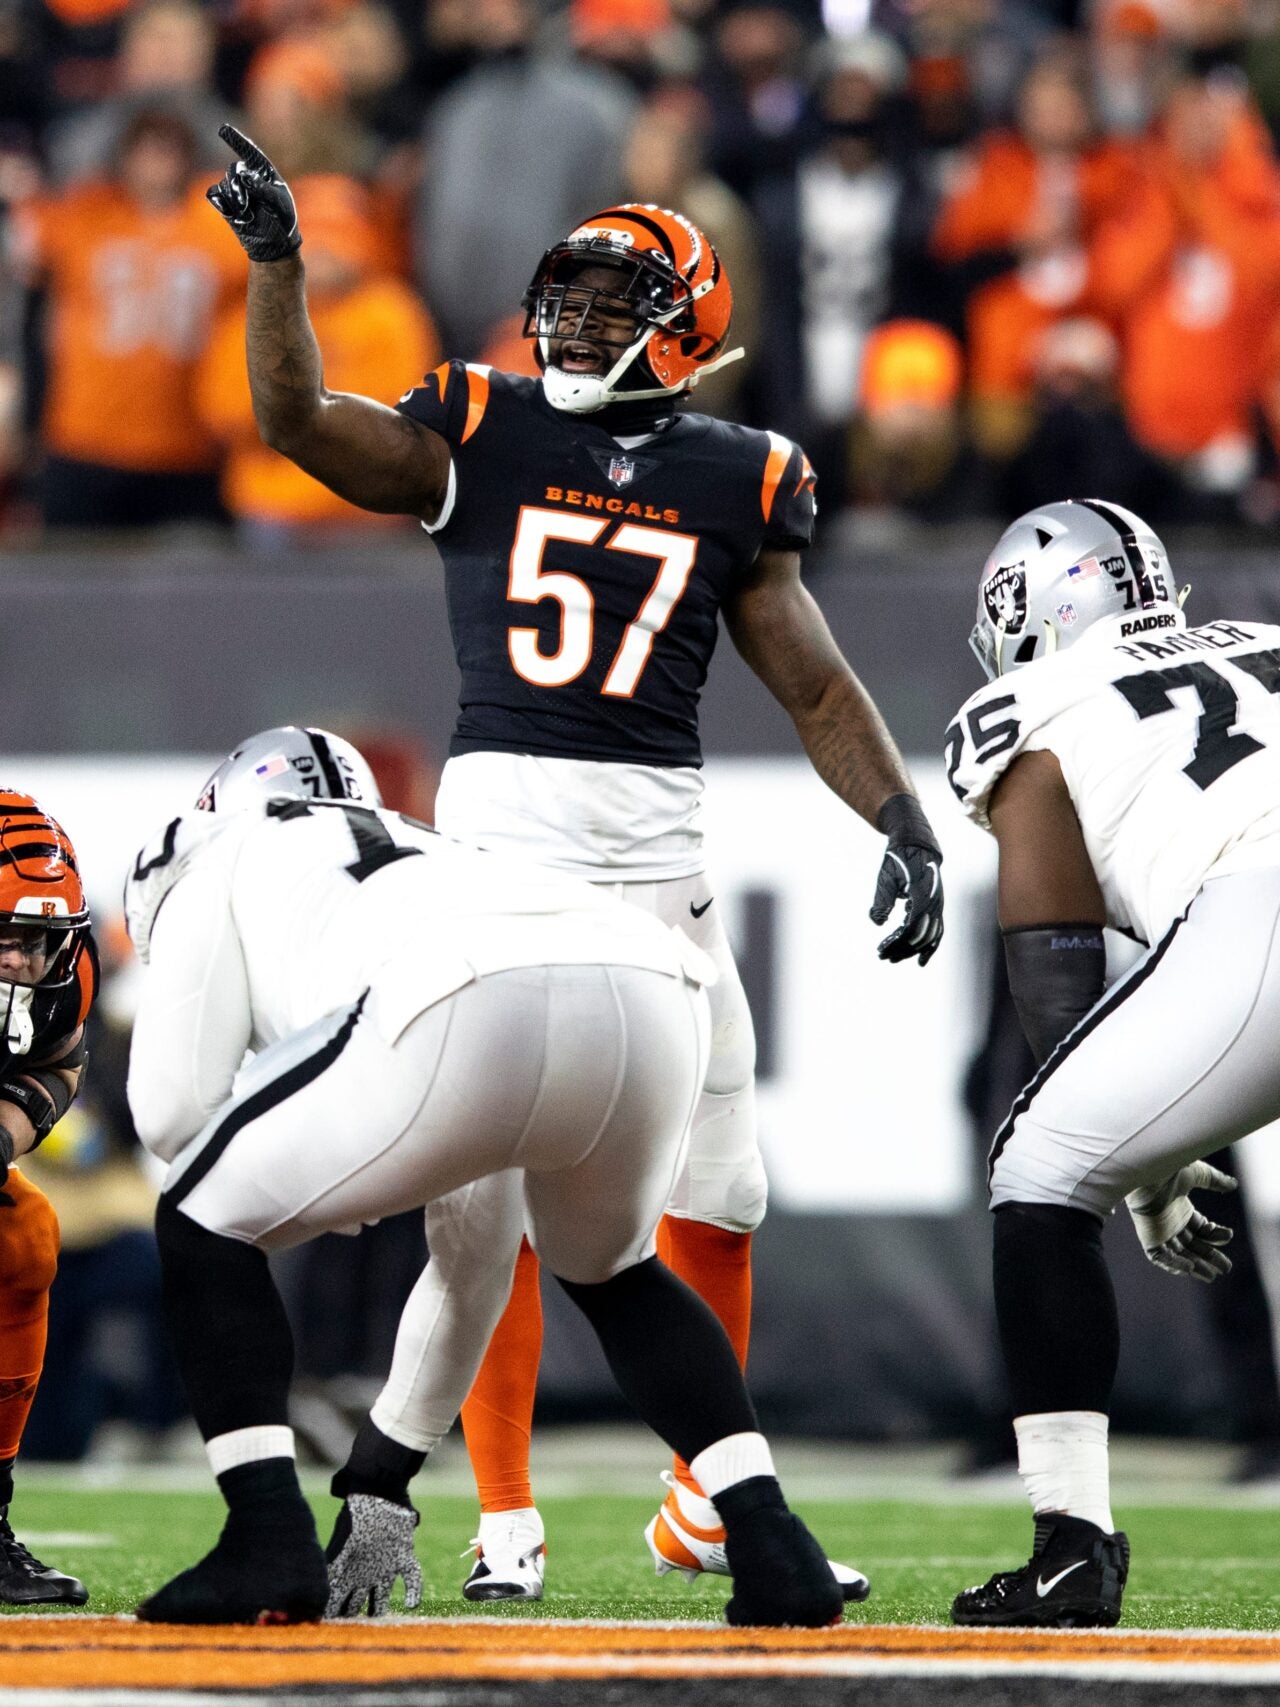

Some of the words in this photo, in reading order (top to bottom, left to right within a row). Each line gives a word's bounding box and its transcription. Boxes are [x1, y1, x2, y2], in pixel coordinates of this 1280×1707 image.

[544, 486, 681, 525] BENGALS
[506, 504, 700, 699] 57
[1120, 613, 1177, 638] RAIDERS
[943, 693, 1022, 802] 75
